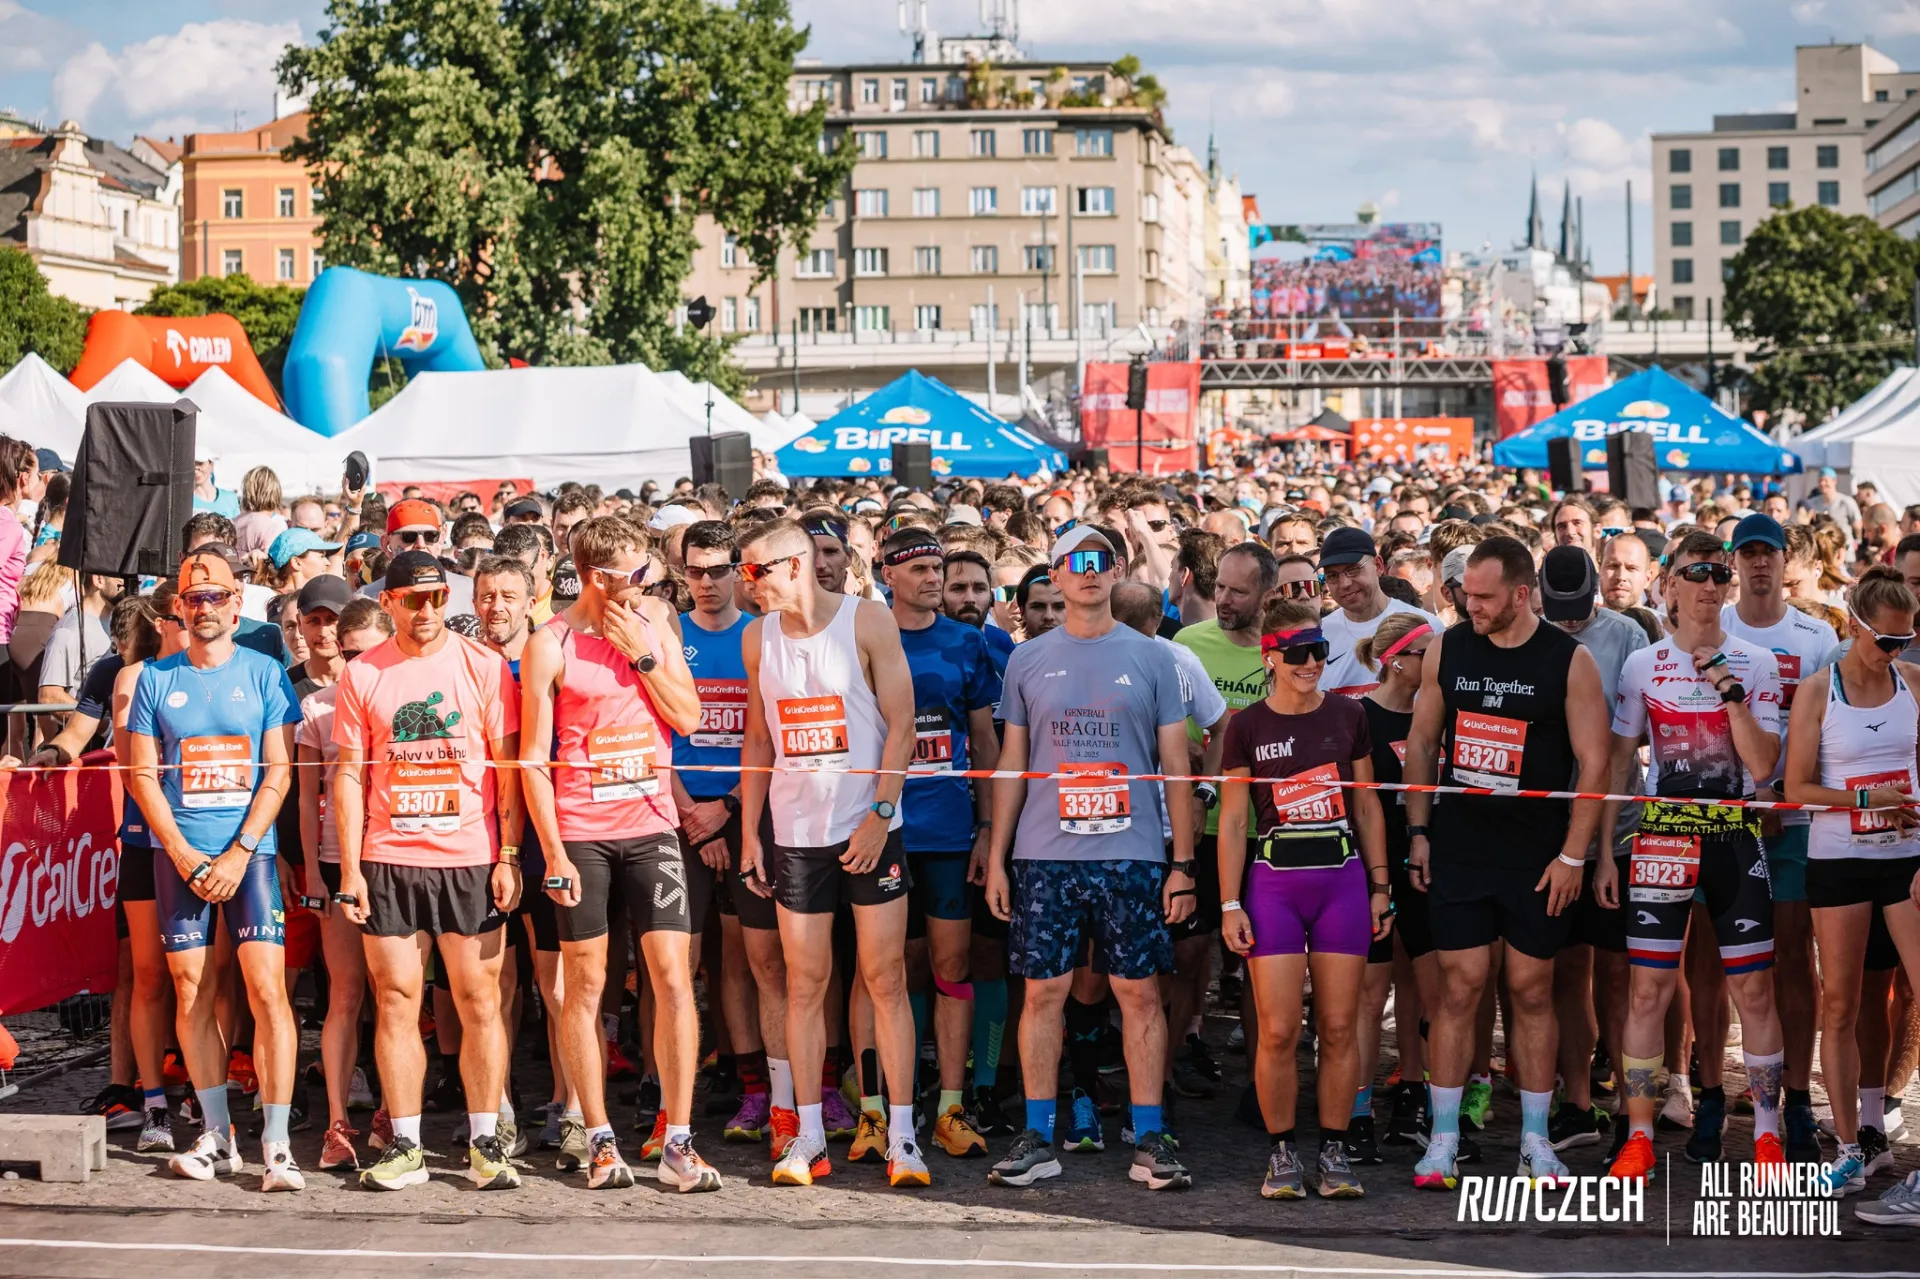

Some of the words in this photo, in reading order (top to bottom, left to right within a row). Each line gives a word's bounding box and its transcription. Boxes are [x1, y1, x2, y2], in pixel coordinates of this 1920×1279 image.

[189, 336, 232, 364] ORLEN
[1654, 663, 1678, 671] EJOT
[735, 686, 748, 694] Ban
[1455, 676, 1480, 691] Run
[1482, 677, 1534, 695] Together.
[792, 705, 819, 714] UniCredit
[819, 704, 836, 712] Bank
[1064, 708, 1105, 718] GENERALI
[699, 709, 744, 730] 2501
[926, 714, 943, 723] Bank
[1051, 721, 1120, 737] PRAGUE
[1470, 720, 1500, 732] UniCredit
[1501, 725, 1518, 735] Bank
[604, 733, 633, 744] UniCredit
[634, 731, 649, 740] Bank
[787, 728, 834, 752] 4033
[835, 736, 843, 748] A
[1072, 739, 1120, 748] MARATHON
[196, 743, 225, 751] UniCredit
[226, 743, 243, 751] Bank
[438, 746, 467, 760] běhu
[1458, 743, 1508, 771] 3320
[1508, 761, 1516, 773] A
[191, 766, 237, 789] 2734
[239, 776, 246, 787] A
[407, 768, 436, 776] UniCredit
[437, 767, 453, 775] Bank
[397, 791, 446, 813] 3307
[447, 800, 454, 811] A
[1065, 793, 1117, 816] 3329
[1117, 801, 1125, 813] A
[1672, 822, 1743, 834] TRIATHLON
[1646, 837, 1675, 847] UniCredit
[1635, 861, 1685, 885] 3923
